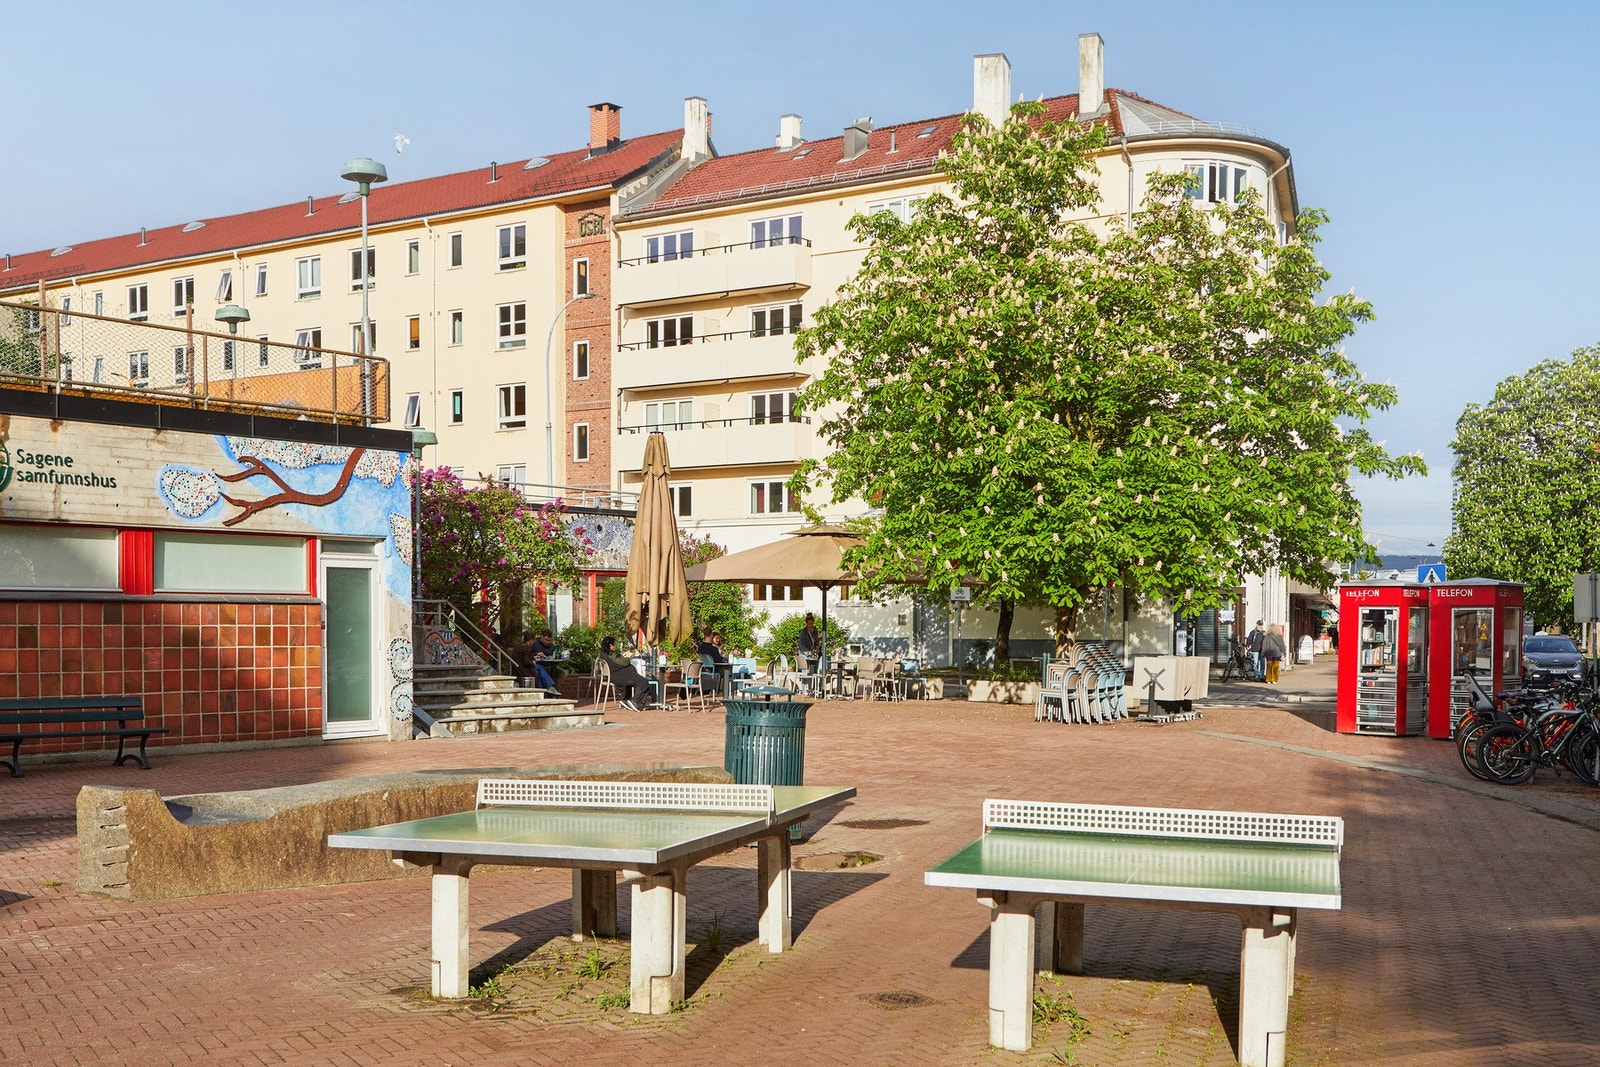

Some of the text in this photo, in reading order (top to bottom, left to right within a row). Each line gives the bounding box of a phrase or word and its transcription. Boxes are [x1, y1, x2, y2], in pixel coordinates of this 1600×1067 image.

[16, 448, 74, 469] Sagene
[16, 469, 117, 488] samfunnshus
[1345, 589, 1380, 597] TELEFON
[1402, 589, 1420, 598] TELEFON
[1436, 588, 1473, 597] TELEFON
